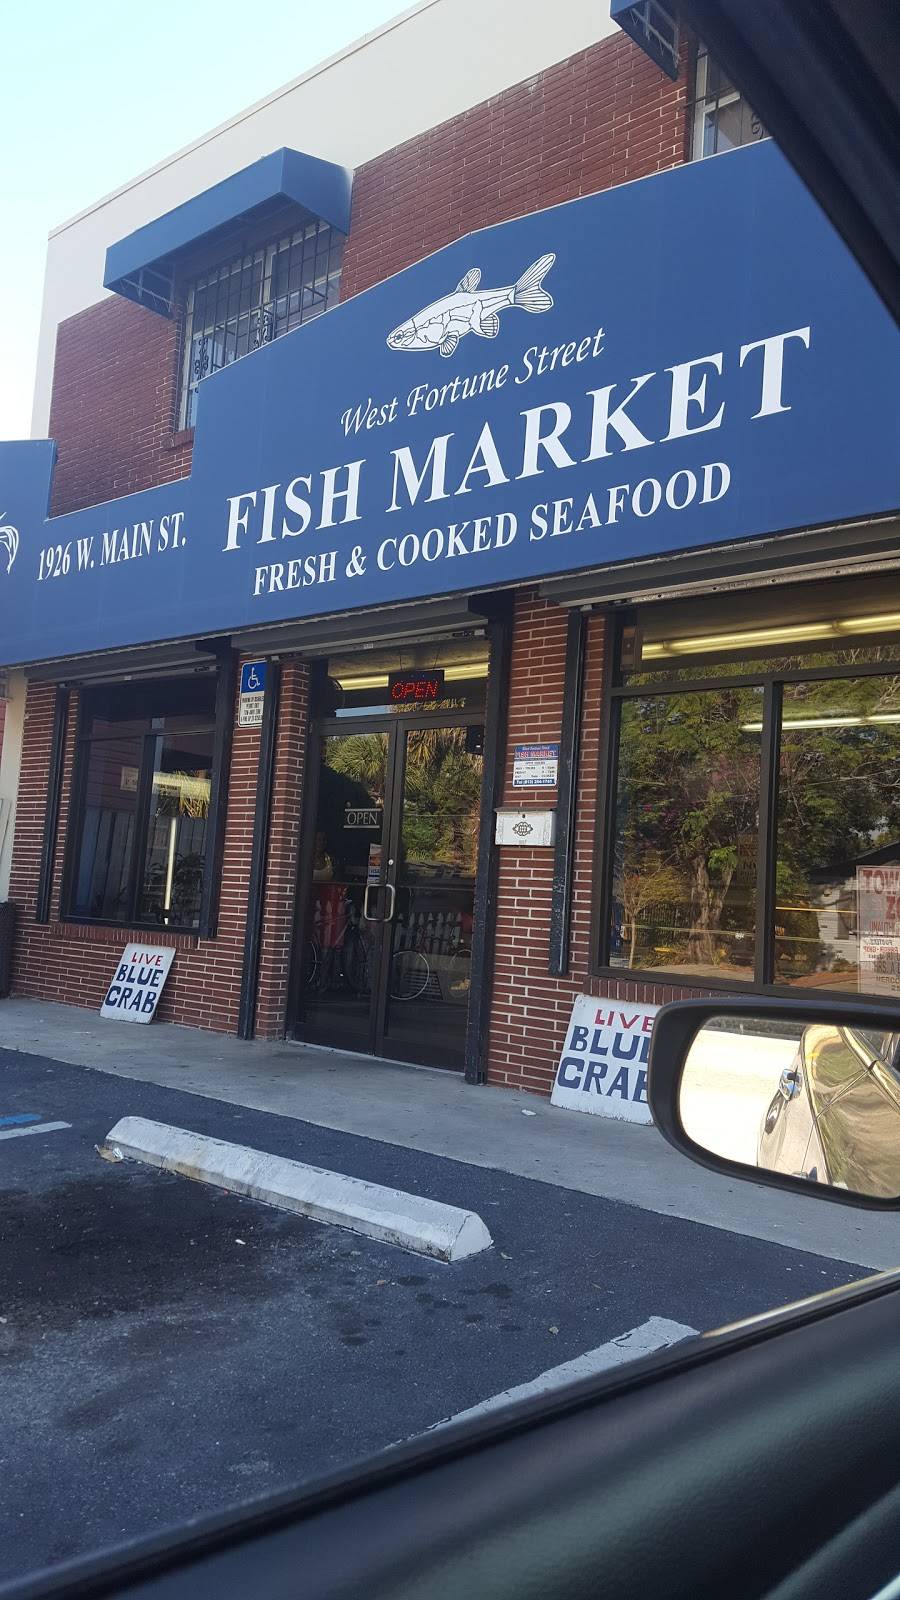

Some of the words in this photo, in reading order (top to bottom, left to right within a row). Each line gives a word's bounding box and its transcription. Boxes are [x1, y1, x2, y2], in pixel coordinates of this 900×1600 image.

[341, 397, 399, 437] West
[406, 364, 509, 417] Fortune
[514, 327, 606, 384] Street
[222, 459, 367, 552] FISH
[385, 326, 811, 513] MARKET
[252, 551, 339, 596] FRESH
[345, 545, 367, 578] &
[376, 512, 518, 571] COOKED
[529, 462, 731, 542] SEAFOOD
[36, 541, 72, 581] 1926
[76, 536, 94, 572] W.
[99, 519, 154, 566] MAIN
[157, 511, 187, 553] ST.
[391, 681, 438, 698] OPEN
[347, 811, 378, 825] OPEN
[131, 951, 164, 966] LIVE
[116, 964, 164, 987] BLUE
[104, 985, 157, 1013] CRAB
[594, 1008, 656, 1032] LIVE
